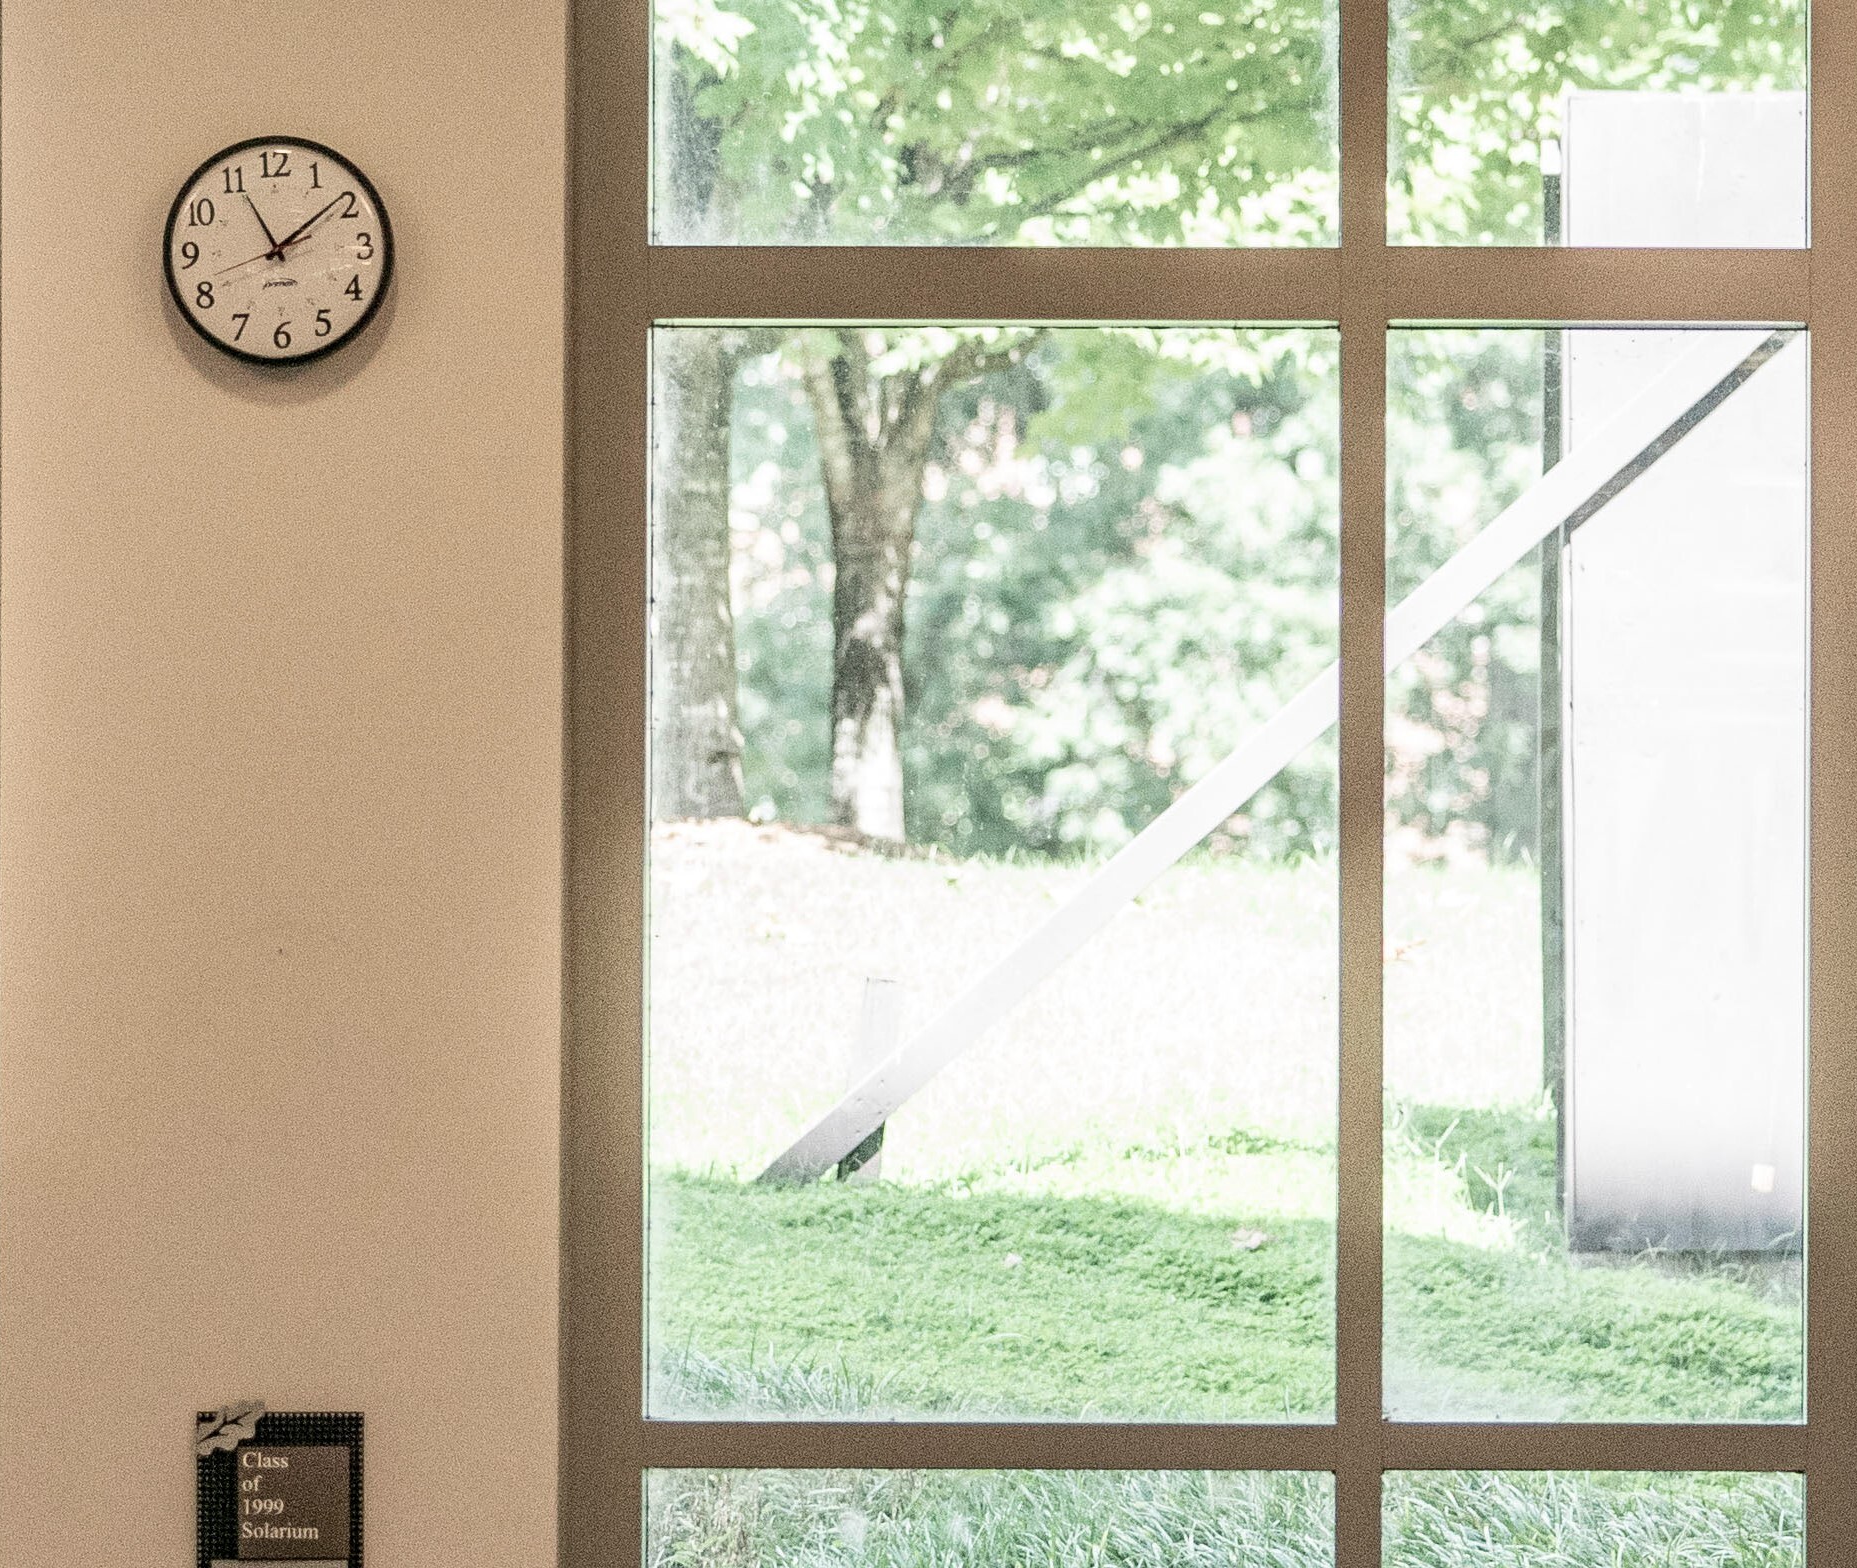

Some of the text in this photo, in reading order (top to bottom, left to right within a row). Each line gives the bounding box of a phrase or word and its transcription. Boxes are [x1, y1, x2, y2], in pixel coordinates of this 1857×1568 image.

[259, 151, 292, 178] 12
[309, 162, 323, 189] 1
[222, 166, 247, 194] 11
[188, 198, 215, 227] 10
[340, 191, 360, 219] 2
[181, 241, 200, 270] 9
[356, 232, 374, 260] 3
[196, 281, 215, 309] 8
[344, 274, 363, 301] 4
[231, 313, 250, 341] 7
[273, 321, 292, 349] 6
[314, 309, 332, 337] 5
[242, 1451, 289, 1468] Class
[242, 1475, 262, 1492] of
[243, 1498, 284, 1516] 1999
[242, 1521, 319, 1540] Solarium
